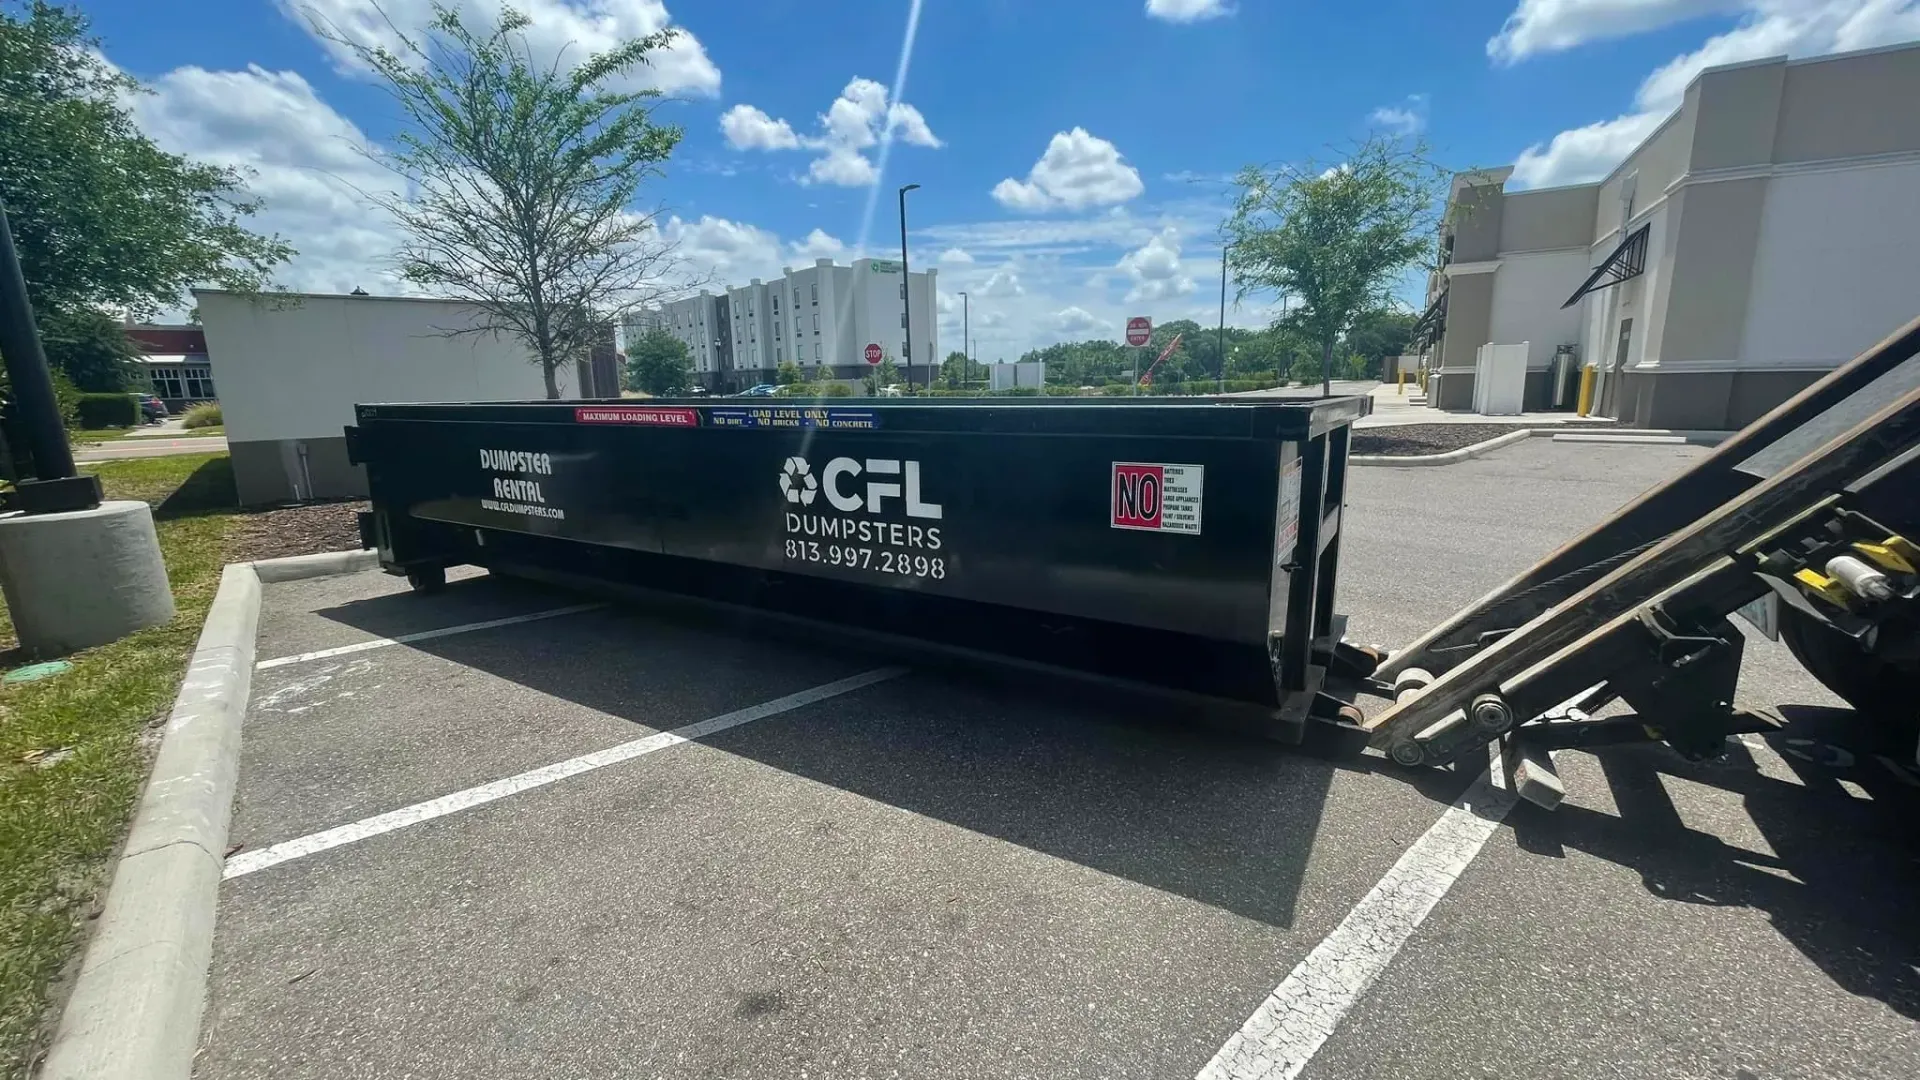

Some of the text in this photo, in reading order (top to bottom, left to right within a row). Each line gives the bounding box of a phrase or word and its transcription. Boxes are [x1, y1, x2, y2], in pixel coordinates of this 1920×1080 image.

[866, 350, 880, 358] STOP
[583, 413, 688, 423] MAXIMUM LOADING LEVEL
[713, 417, 724, 425] NO
[758, 418, 770, 426] NO
[816, 419, 829, 427] NO
[774, 410, 801, 418] LEVEL
[805, 411, 828, 419] ONLY
[480, 449, 552, 474] DUMPSTER
[494, 478, 545, 503] RENTAL
[823, 457, 942, 519] CFL
[1117, 472, 1160, 521] NO
[481, 499, 564, 520] WWW.CFLDUMPSTERS.COM
[786, 513, 942, 549] DUMPSTERS
[785, 539, 945, 579] 813.997.2898
